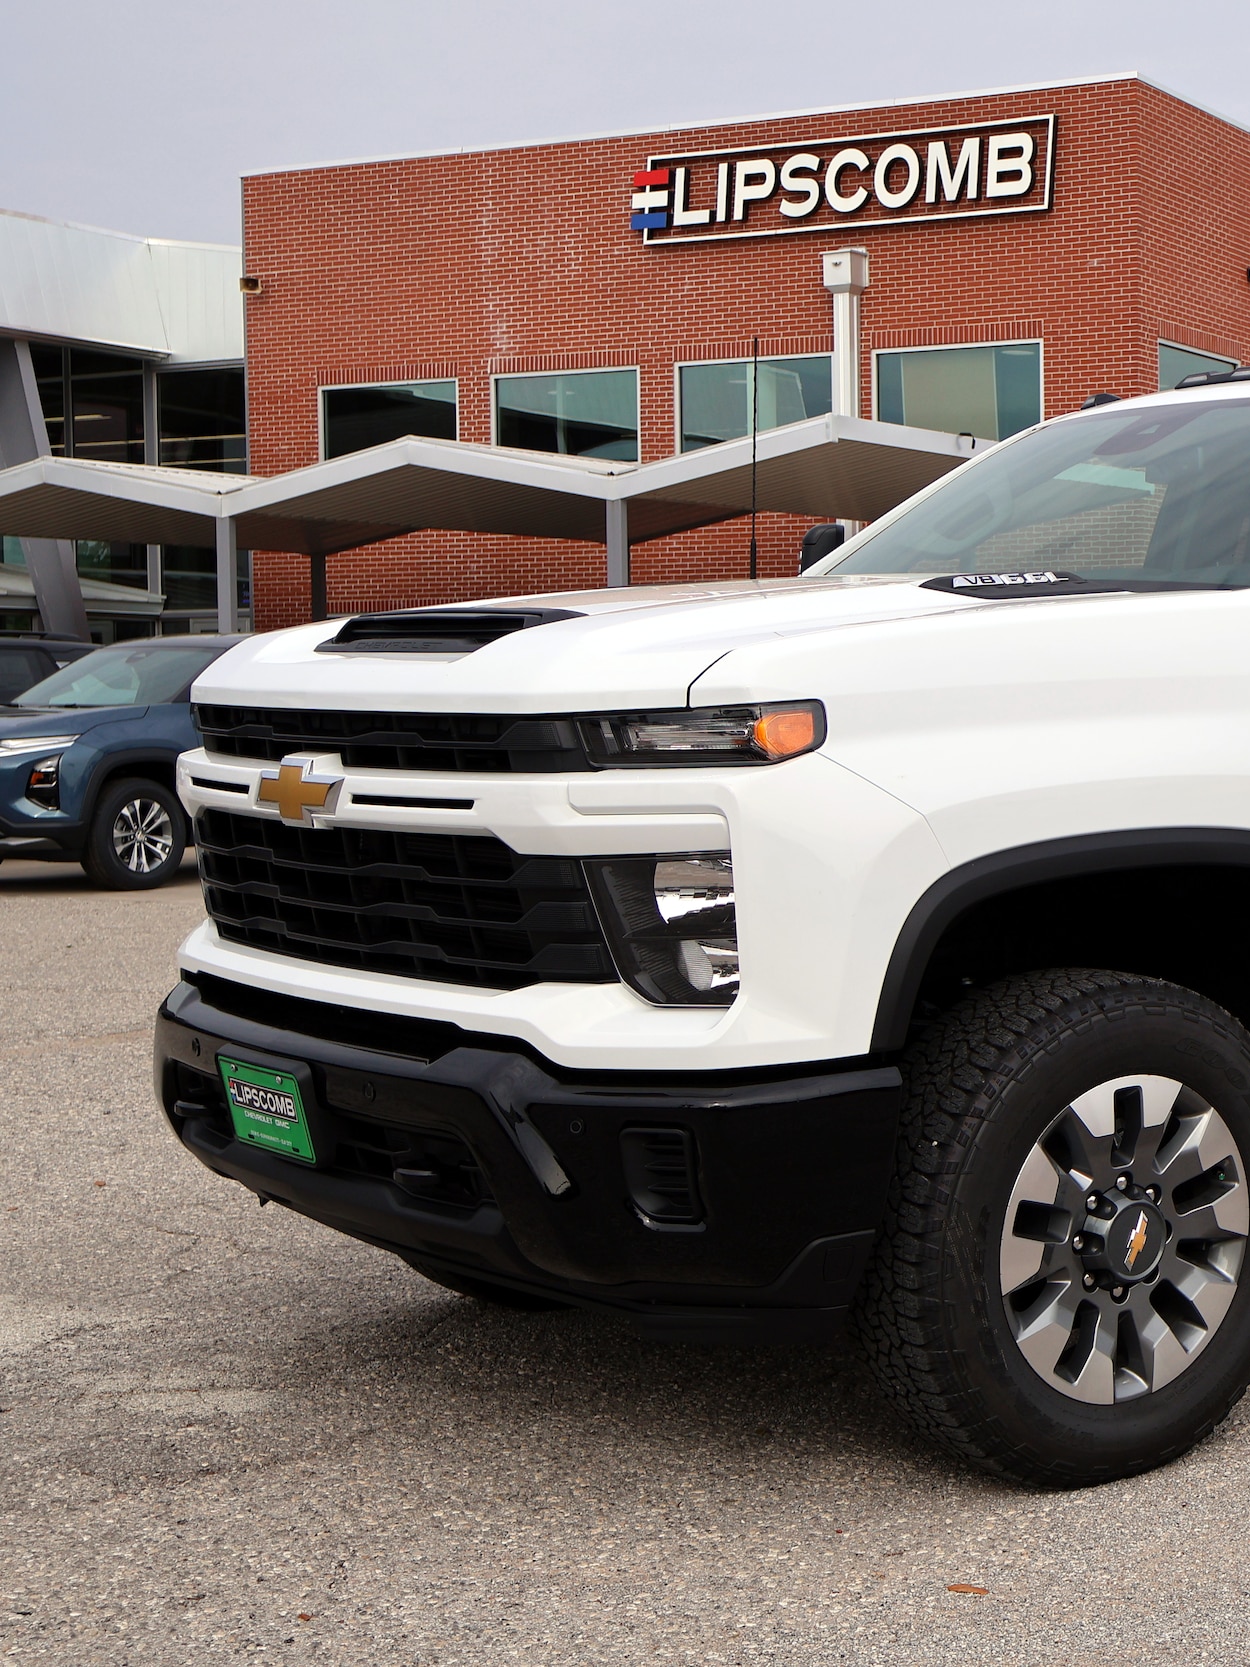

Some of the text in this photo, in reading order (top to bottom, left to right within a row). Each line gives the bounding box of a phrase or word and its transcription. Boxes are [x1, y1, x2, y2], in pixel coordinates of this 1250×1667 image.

[673, 132, 1034, 227] LIPSCOMB
[963, 575, 996, 585] V8
[234, 1083, 296, 1117] LIPSCOMB
[244, 1111, 291, 1130] CHEVROLET GMC
